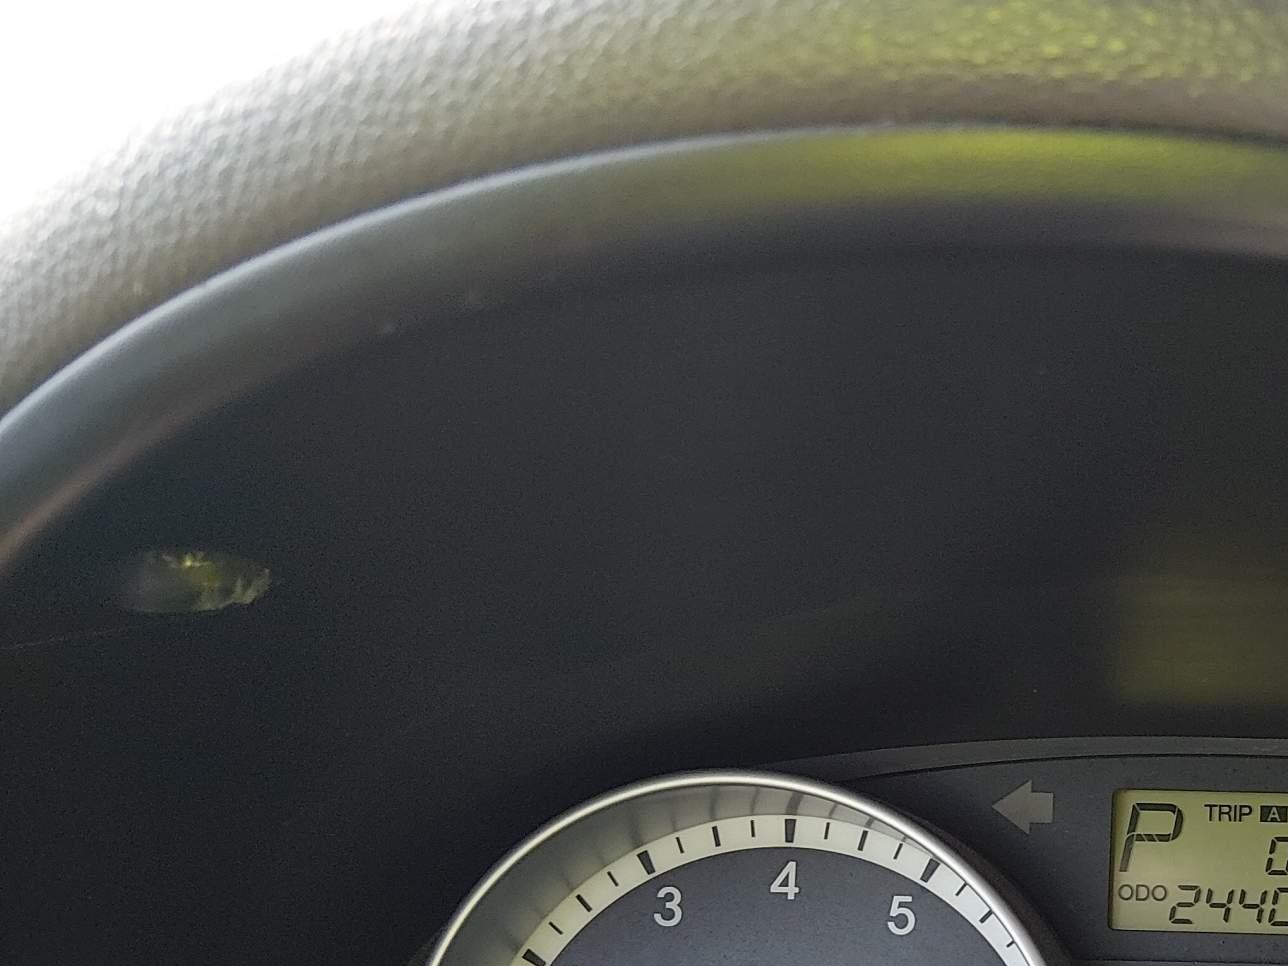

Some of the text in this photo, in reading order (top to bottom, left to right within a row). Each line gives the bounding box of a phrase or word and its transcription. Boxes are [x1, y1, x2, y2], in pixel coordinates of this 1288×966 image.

[1204, 804, 1286, 823] TRIP A
[1118, 802, 1184, 873] P
[770, 861, 799, 901] 4
[1118, 884, 1168, 902] ODO
[653, 886, 683, 927] 3
[887, 895, 916, 936] 5
